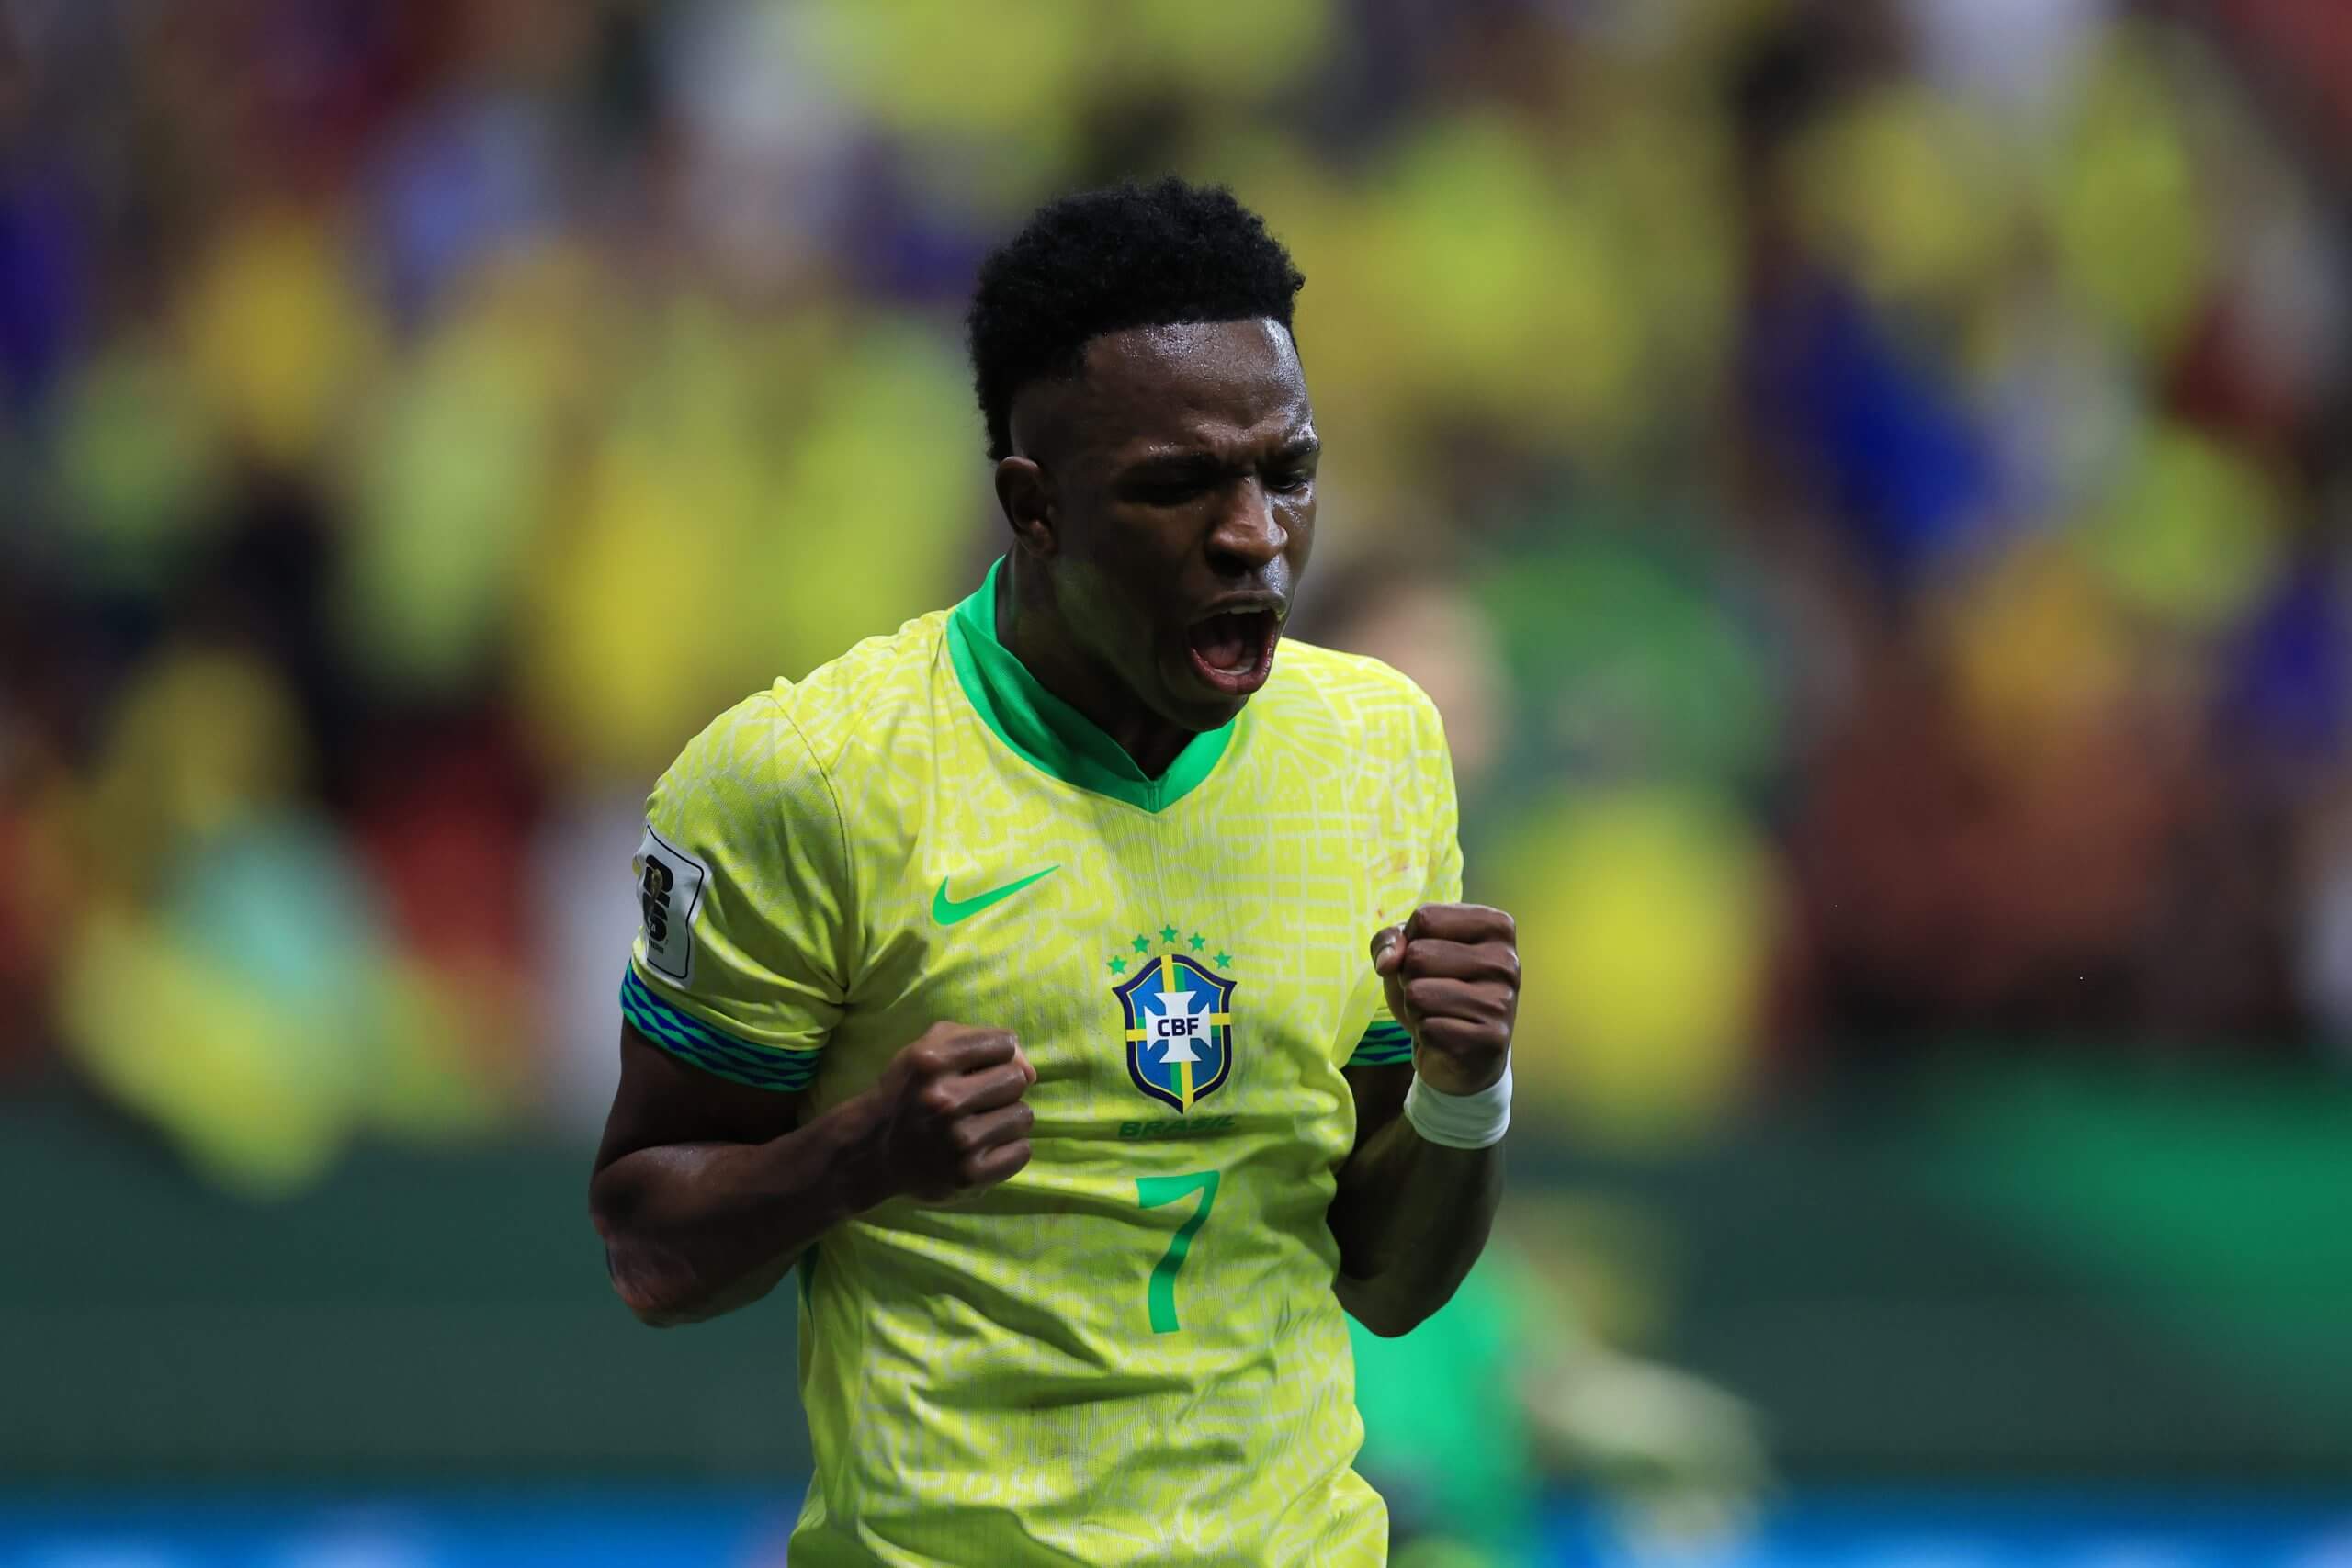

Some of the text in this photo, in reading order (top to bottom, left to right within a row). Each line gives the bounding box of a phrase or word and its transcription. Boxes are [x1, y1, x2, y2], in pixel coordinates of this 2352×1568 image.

[1157, 1017, 1199, 1037] CBF
[1118, 1115, 1235, 1140] BRASIL
[1136, 1170, 1220, 1334] 7
